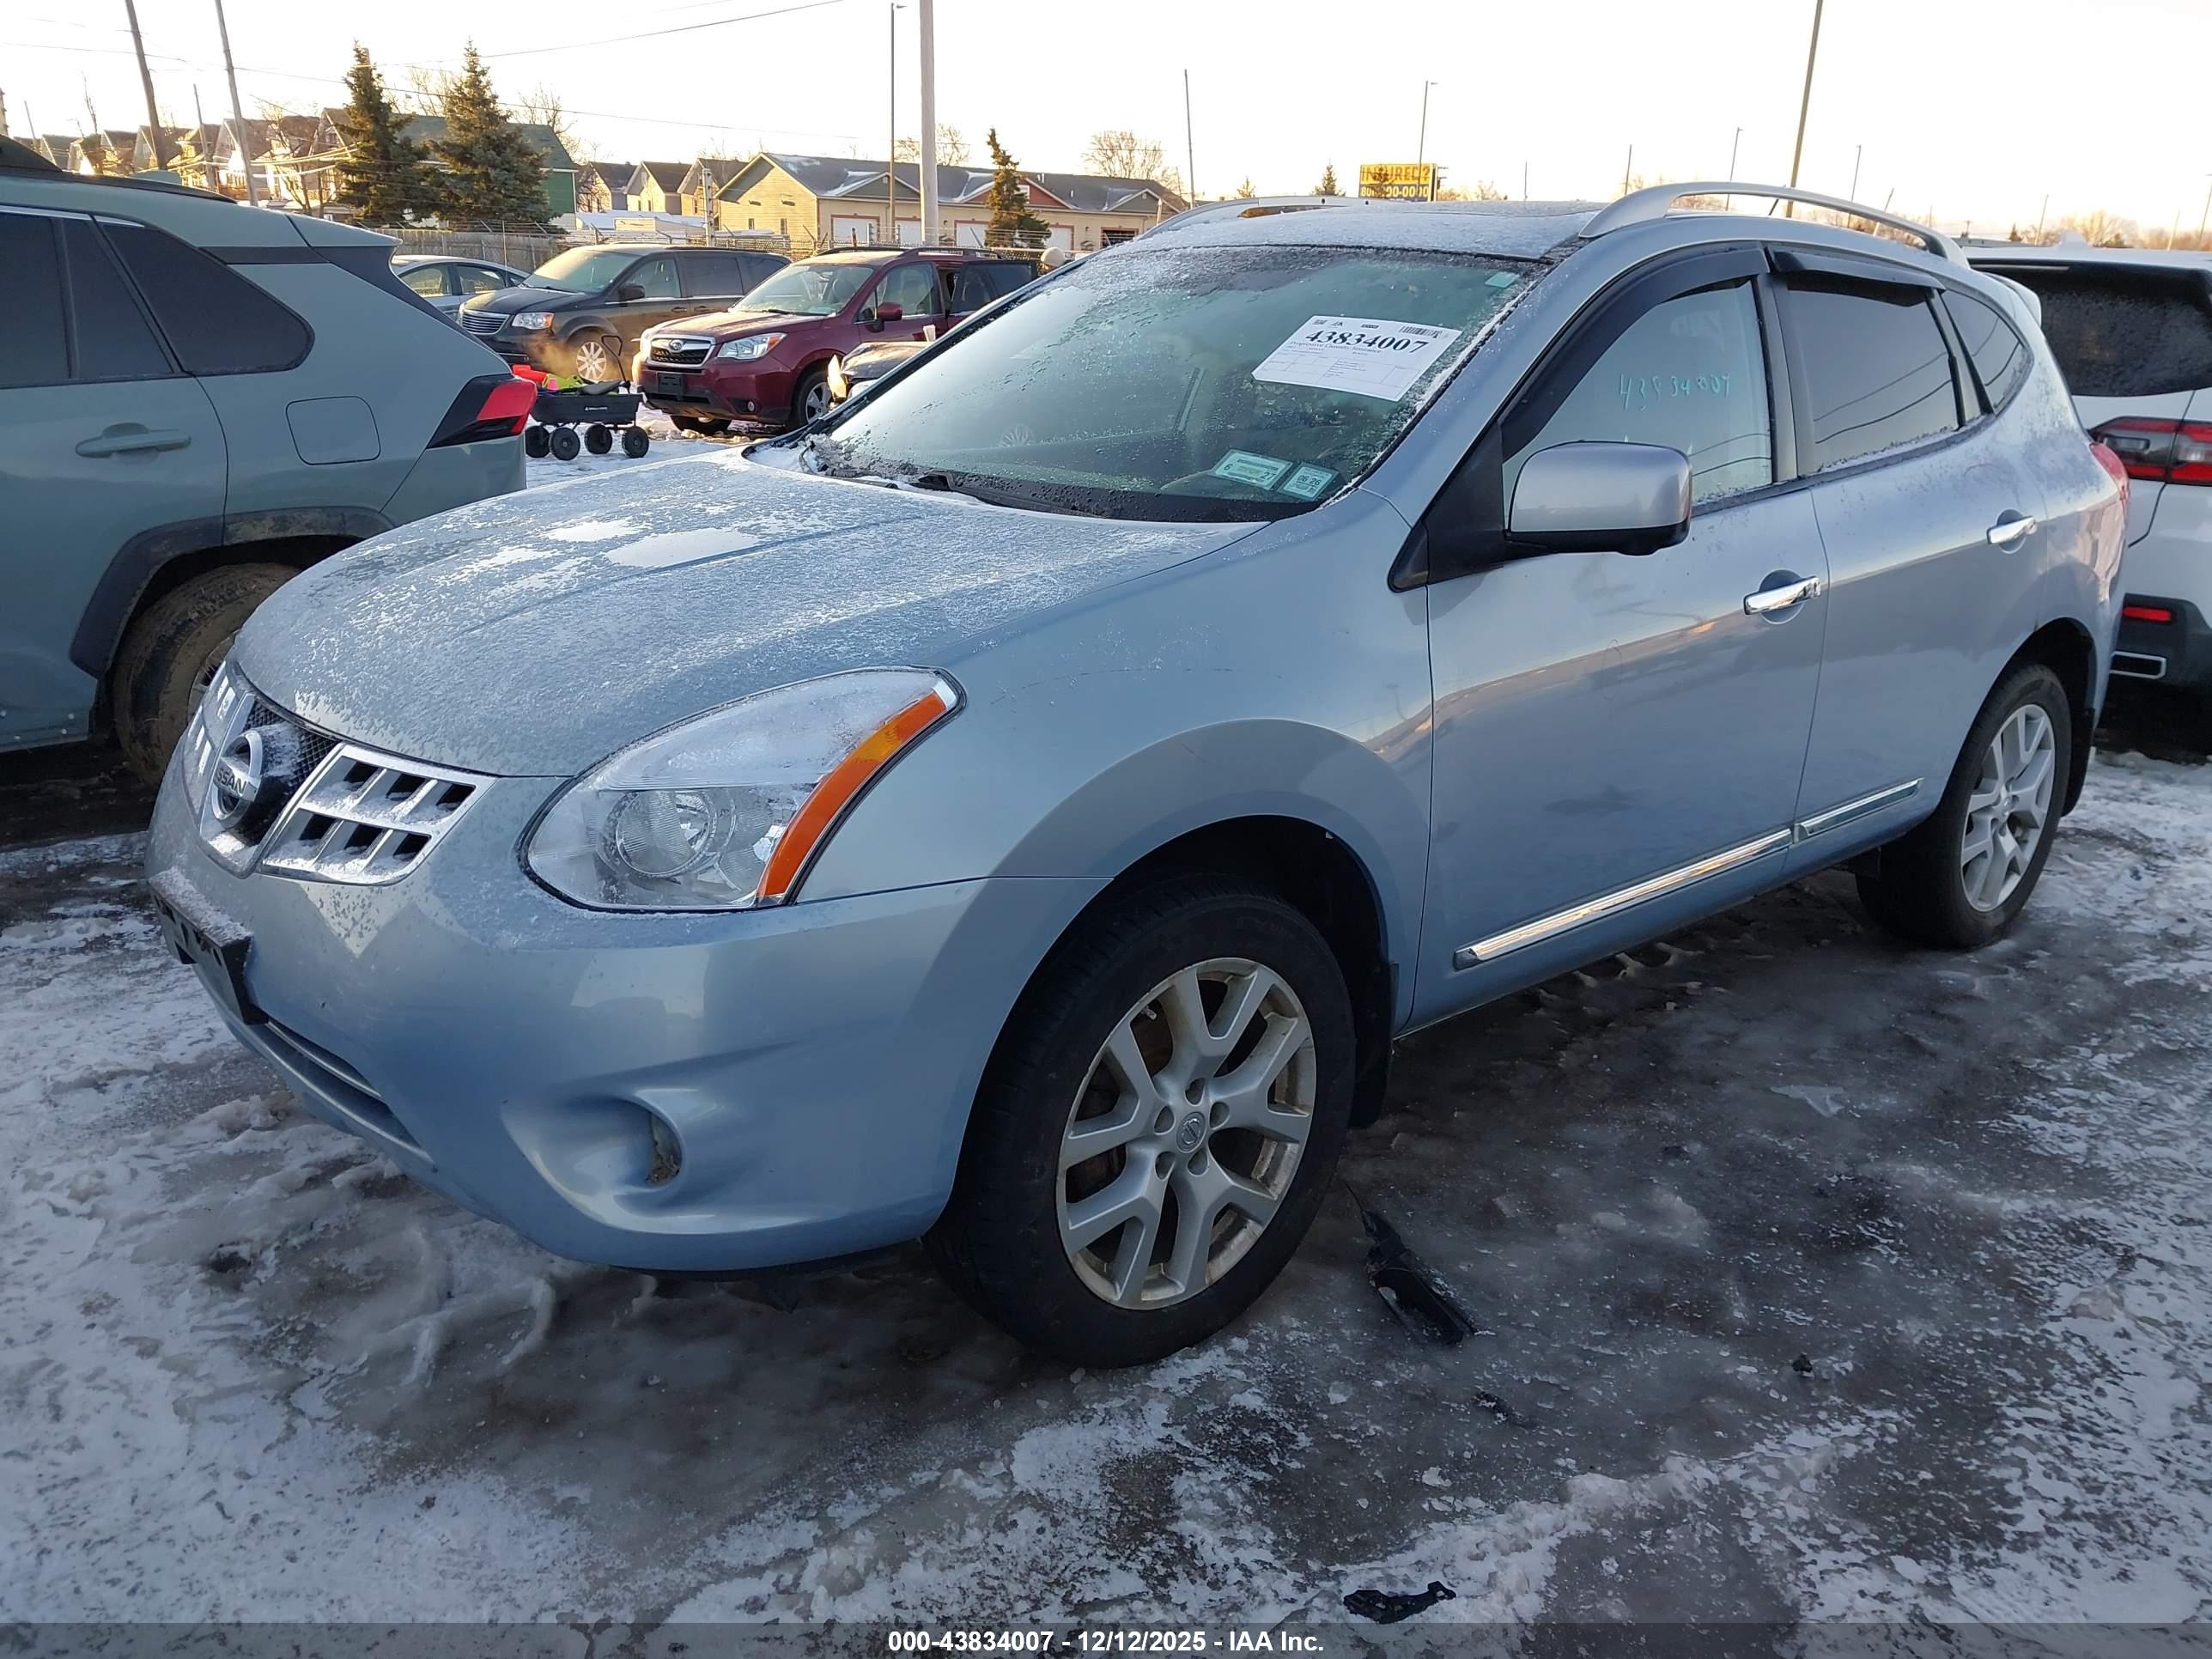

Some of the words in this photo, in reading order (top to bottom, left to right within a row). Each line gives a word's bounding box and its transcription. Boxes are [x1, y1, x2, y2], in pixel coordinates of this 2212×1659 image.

[1361, 166, 1430, 181] INURED?
[1304, 330, 1430, 353] 43834007
[1261, 471, 1277, 481] 27
